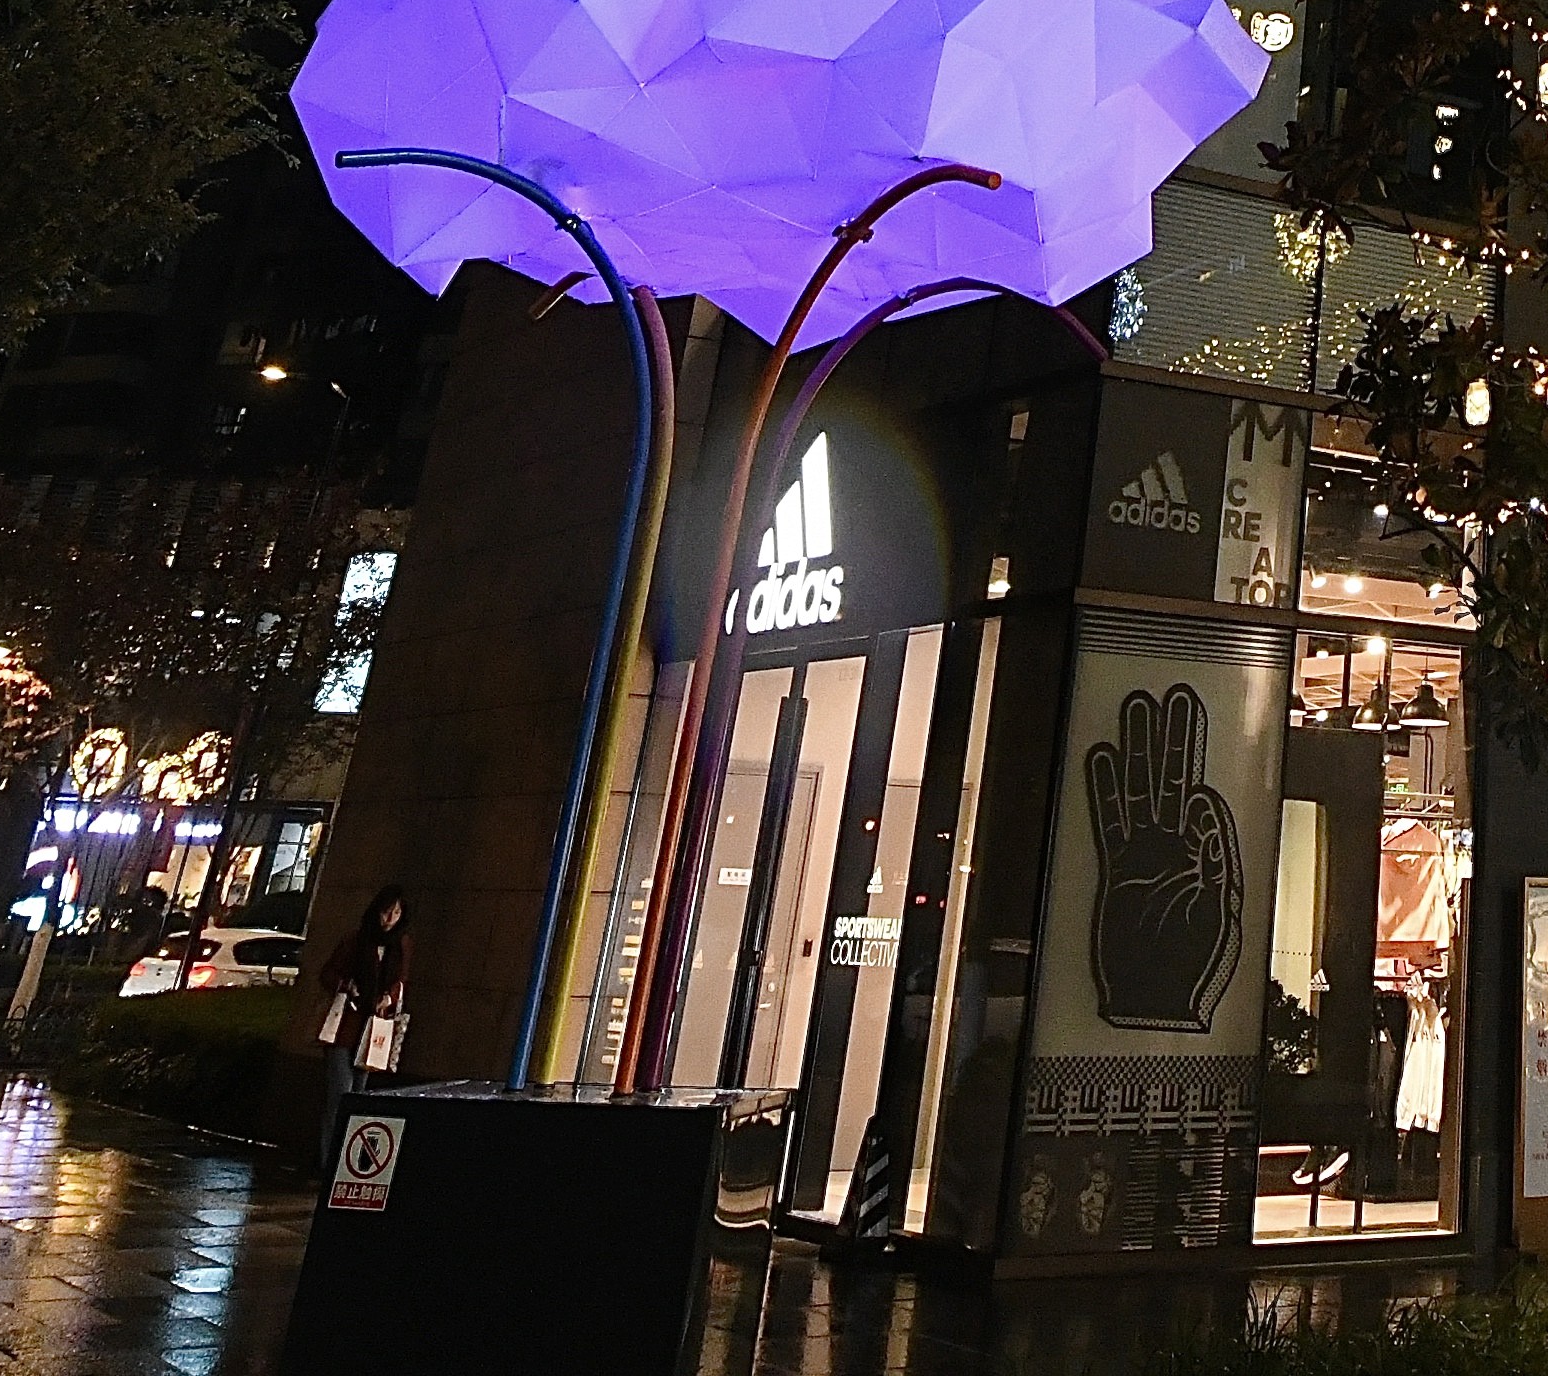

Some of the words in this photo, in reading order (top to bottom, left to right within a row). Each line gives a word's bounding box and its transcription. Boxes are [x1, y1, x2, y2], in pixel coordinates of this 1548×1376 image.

[1108, 497, 1201, 534] adidas
[1221, 508, 1262, 542] RE
[834, 916, 902, 940] SPORTSWEA
[830, 939, 899, 968] COLLECTIV
